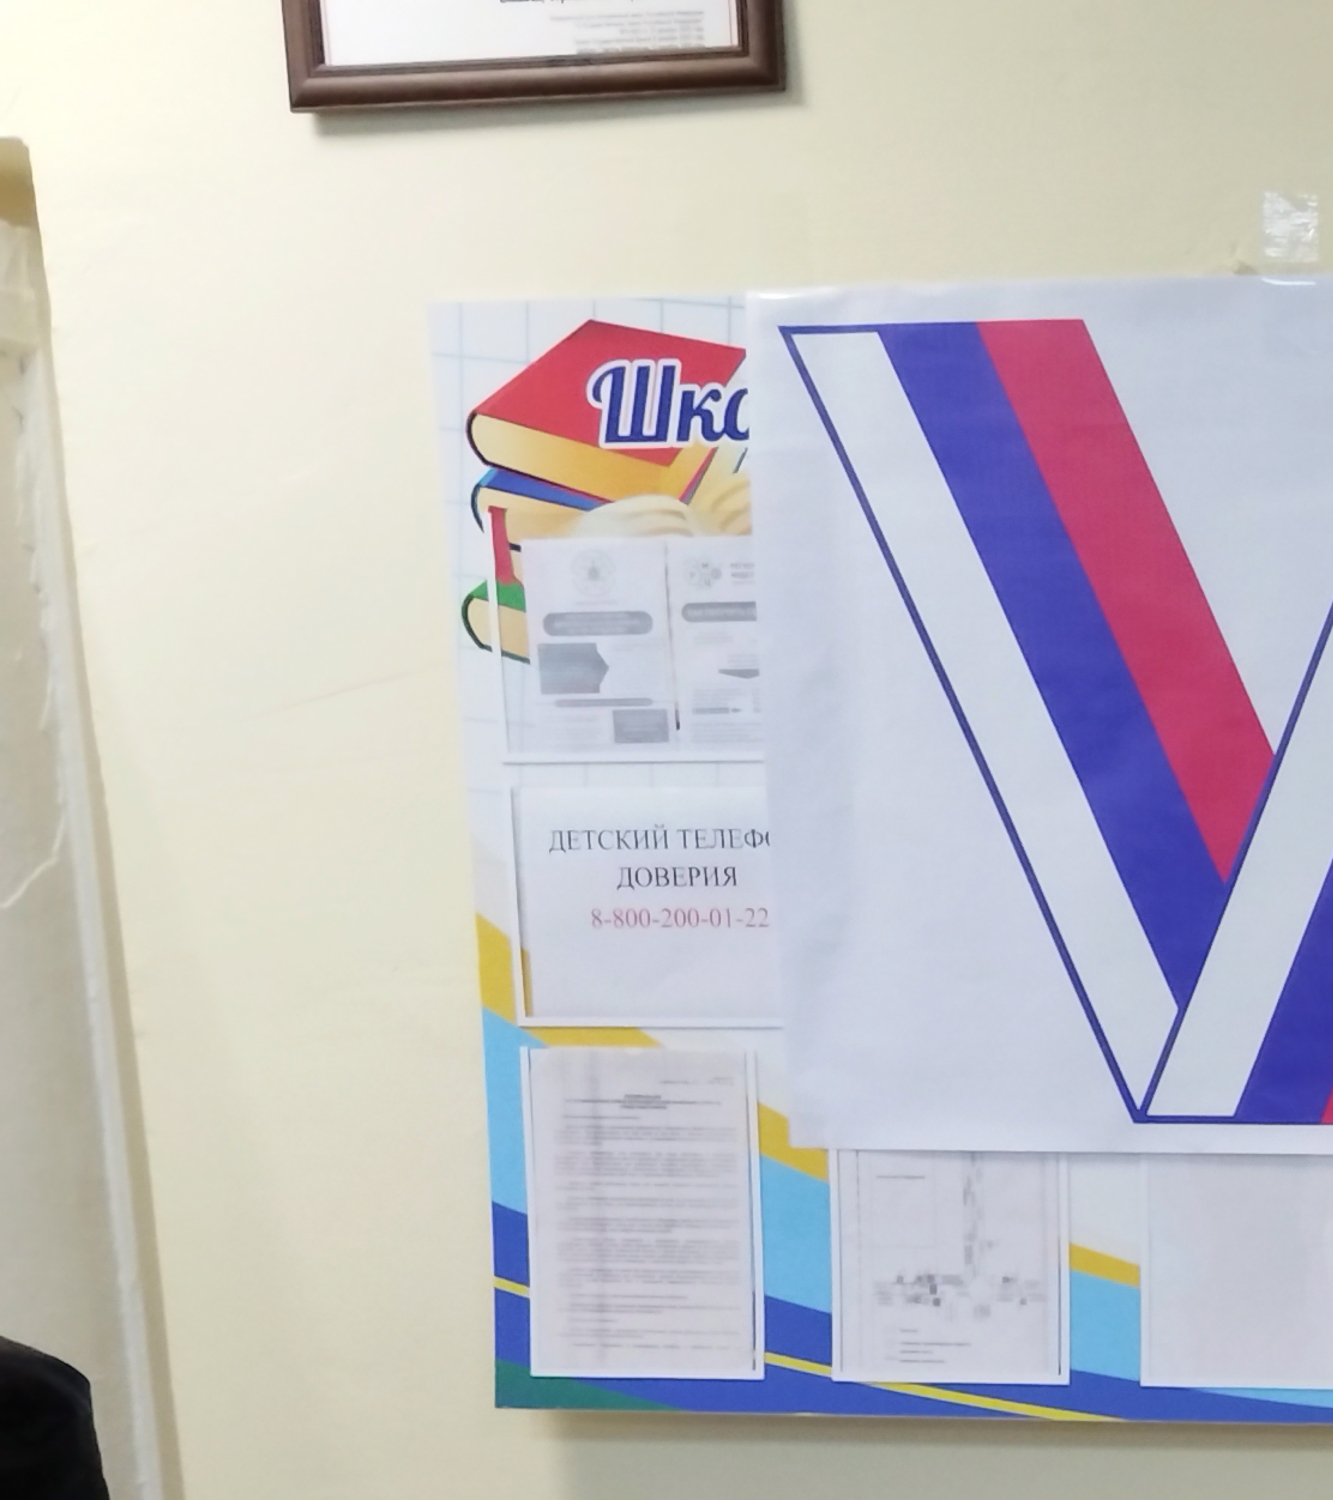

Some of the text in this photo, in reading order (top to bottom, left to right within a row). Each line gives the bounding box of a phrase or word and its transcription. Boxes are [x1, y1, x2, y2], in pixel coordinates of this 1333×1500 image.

[549, 824, 669, 854] ДЕТСКИЙ
[617, 867, 737, 890] ДОВЕРИЯ
[591, 908, 770, 928] 8-800-200-01-22
